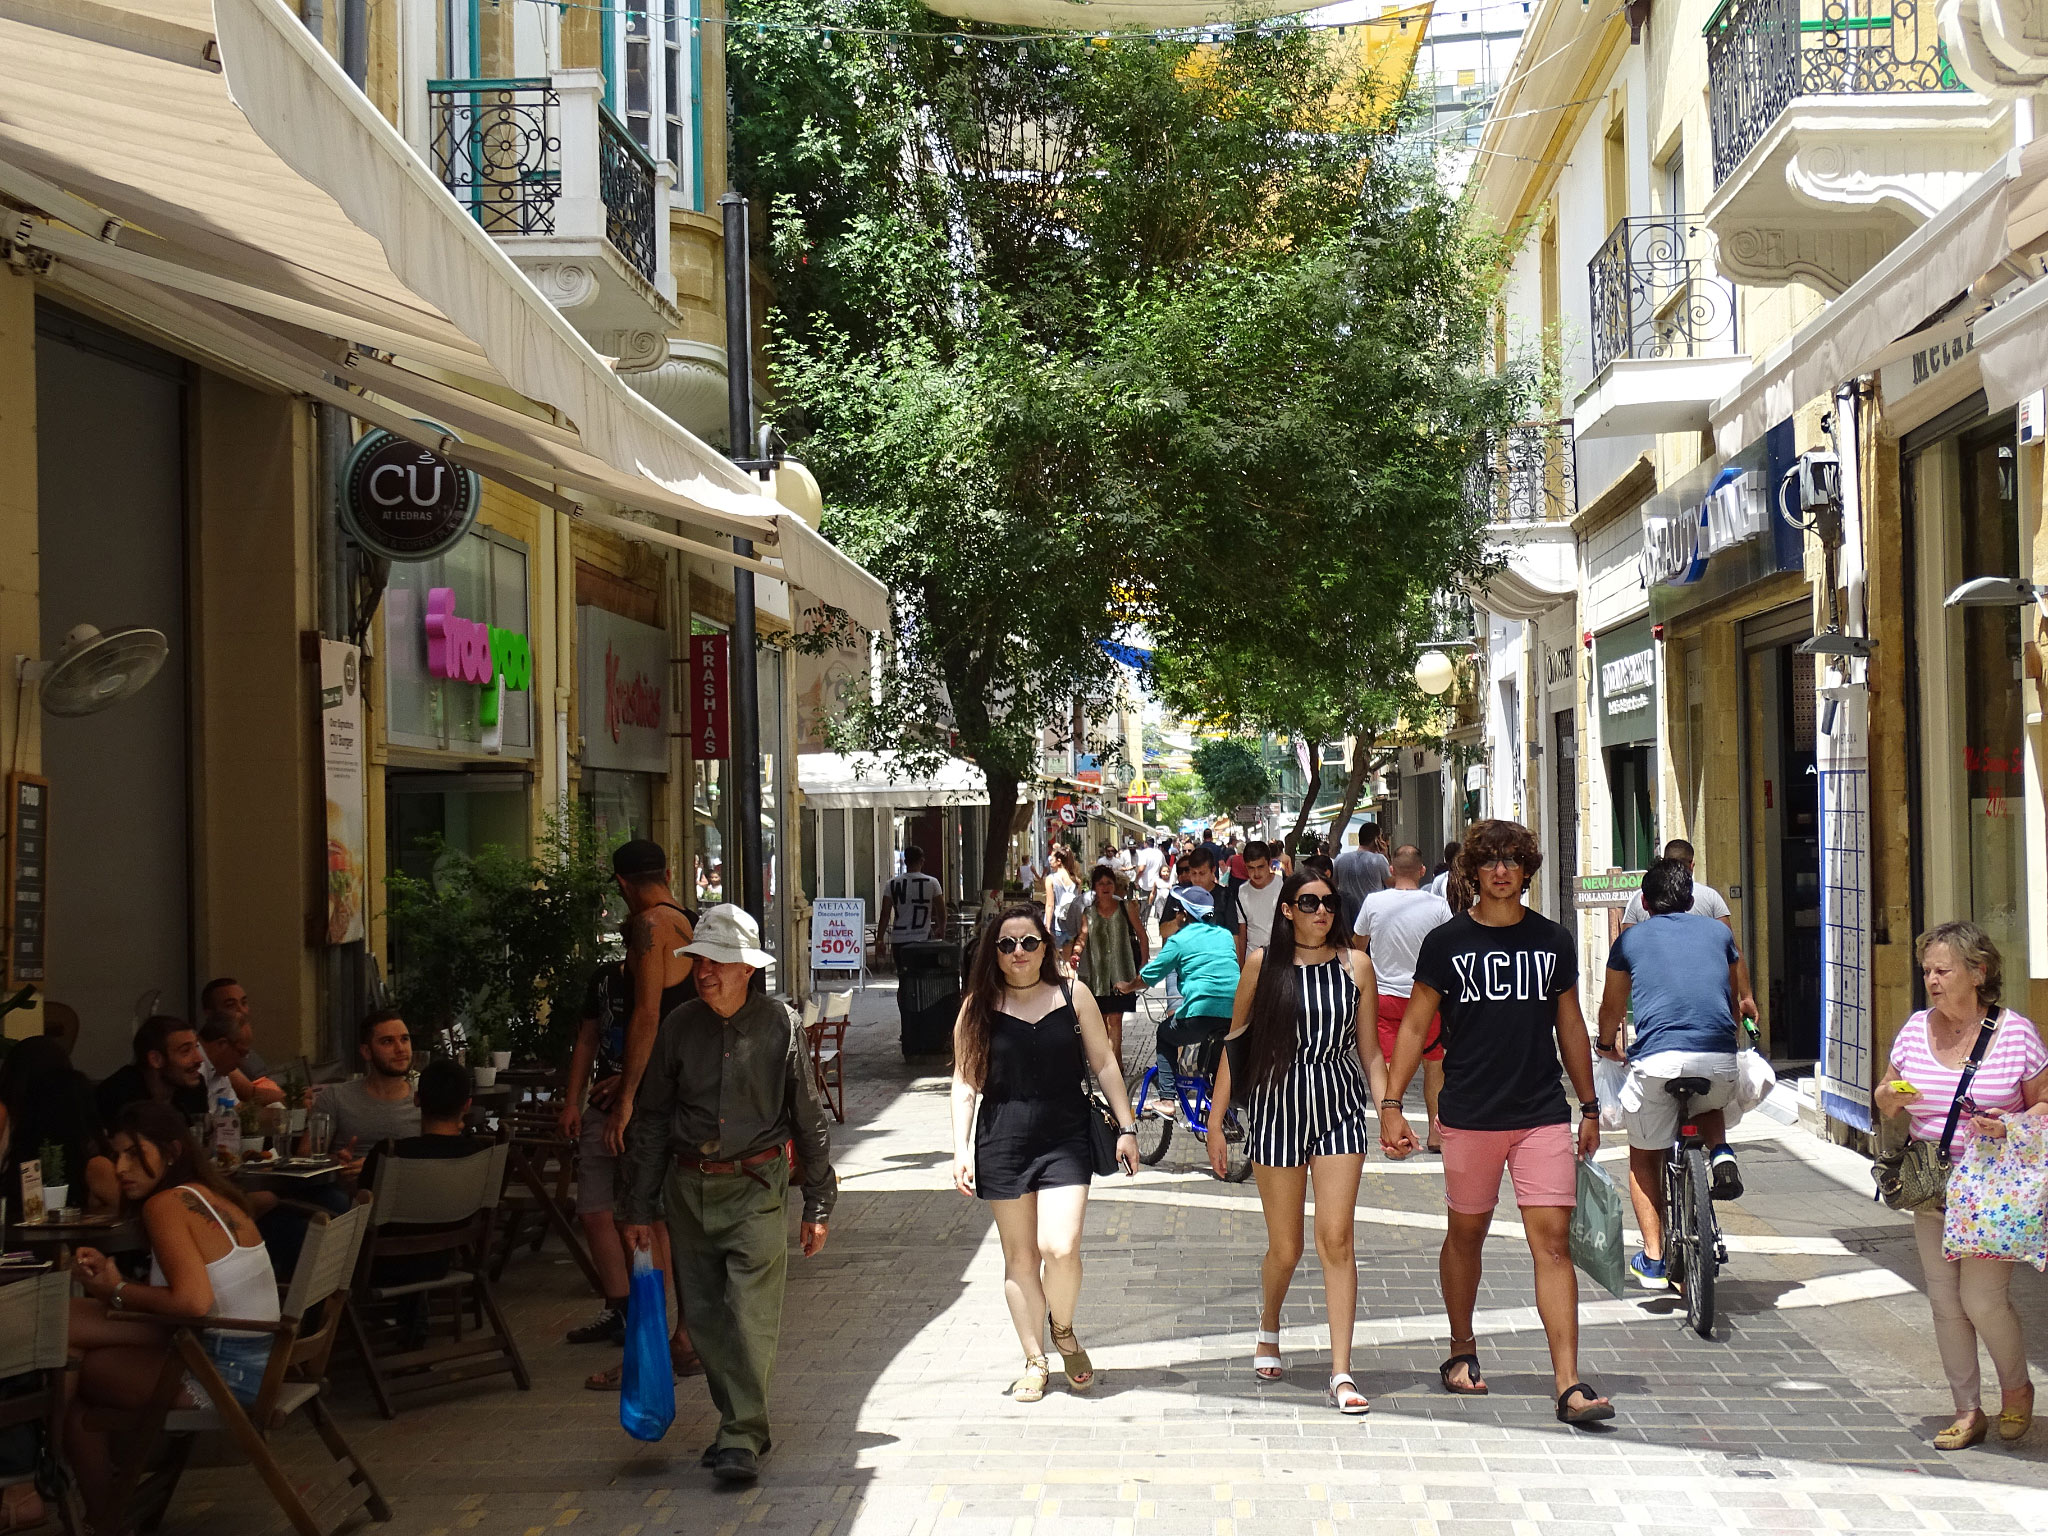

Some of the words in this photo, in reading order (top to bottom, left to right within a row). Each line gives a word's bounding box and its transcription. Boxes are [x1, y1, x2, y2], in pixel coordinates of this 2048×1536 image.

[383, 511, 393, 520] AT
[395, 511, 432, 520] LEDRAS
[702, 640, 716, 754] KRASHIAS
[1582, 877, 1610, 890] NEW
[1578, 891, 1611, 902] HOLLAND
[818, 902, 859, 910] METAXA
[829, 919, 846, 927] ALL
[823, 929, 854, 937] SILVER
[815, 939, 860, 954] -50%
[1452, 951, 1557, 1003] XCIV
